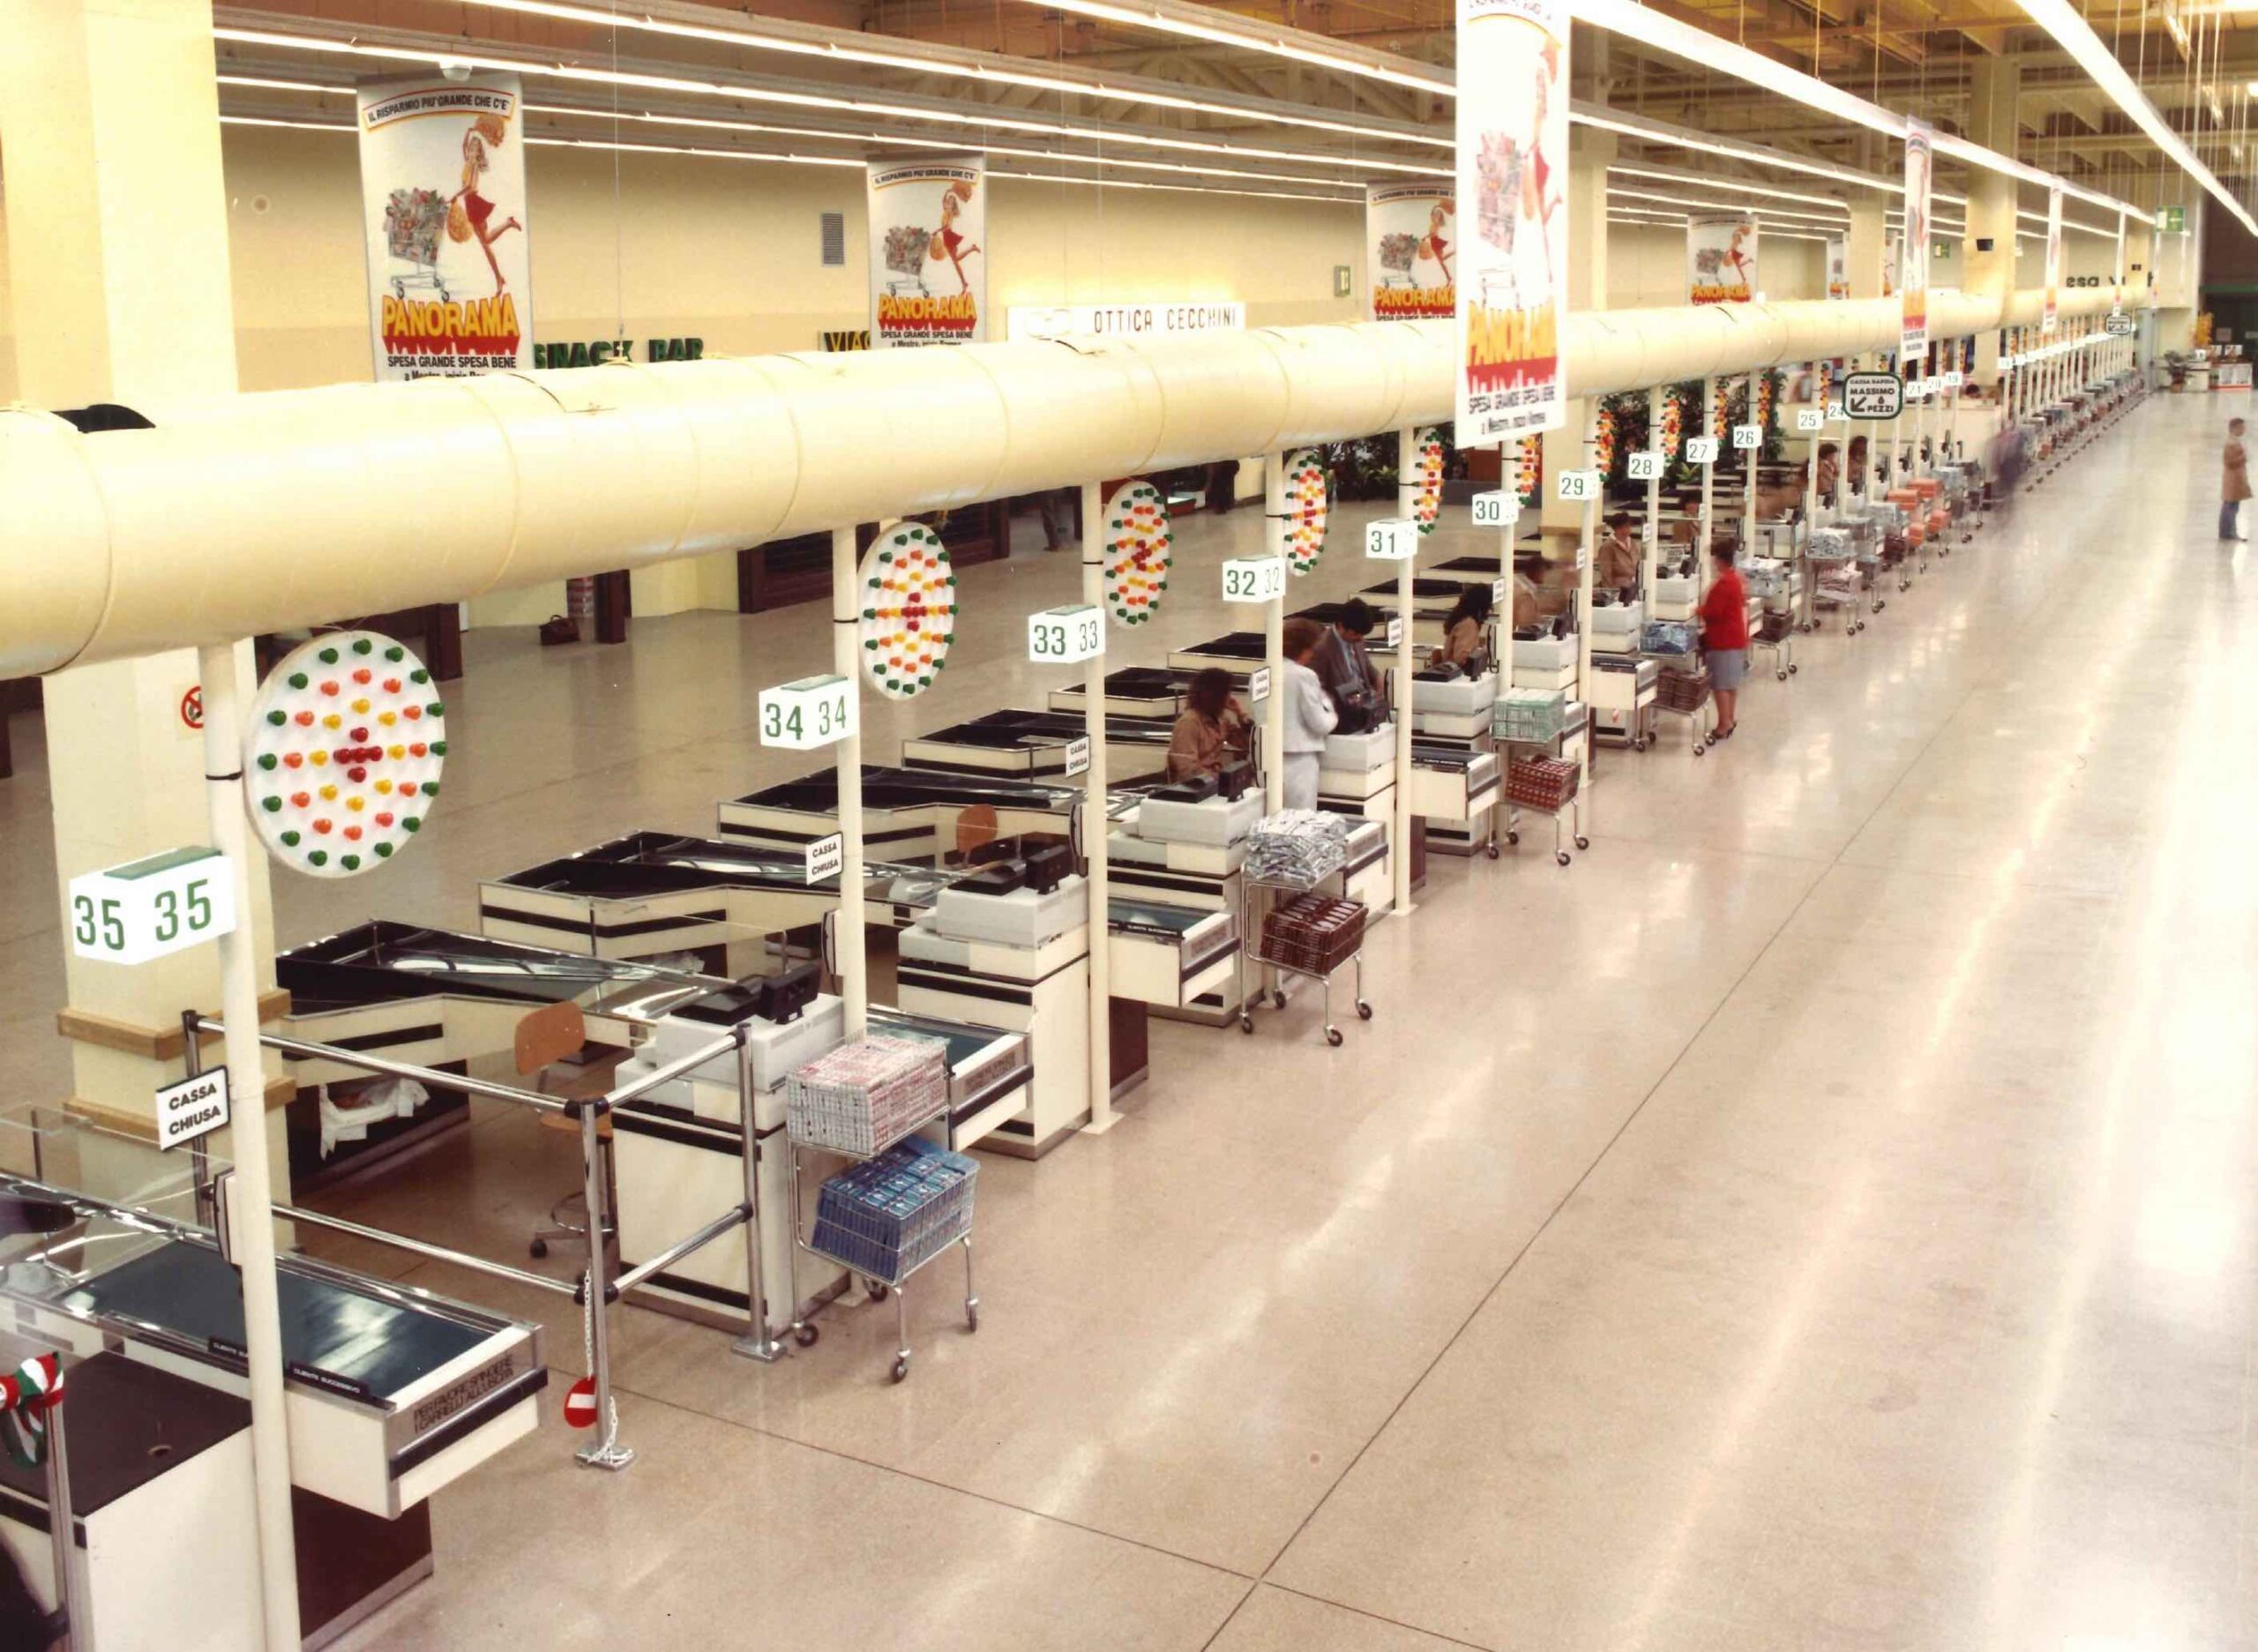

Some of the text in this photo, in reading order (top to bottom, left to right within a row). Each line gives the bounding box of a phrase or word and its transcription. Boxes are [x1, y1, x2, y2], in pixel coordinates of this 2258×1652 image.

[368, 111, 376, 122] IL
[377, 99, 420, 119] RISPARMIO
[437, 94, 473, 107] GRANDE
[475, 96, 491, 107] CHE
[382, 293, 520, 344] PANORAMA
[879, 292, 977, 324] PANORAMA
[1095, 307, 1236, 333] OTTICA CECCHINI
[880, 330, 974, 339] SPESA GRANDE SPESA BENE
[388, 355, 517, 369] SPESA GRANDE SPESA BENE
[649, 338, 705, 363] BAR
[1800, 414, 1817, 427] 25
[1736, 430, 1754, 445] 26
[1689, 444, 1708, 460] 27
[1631, 458, 1653, 475] 28
[1561, 477, 1584, 496] 29
[1475, 500, 1500, 520] 30
[1371, 530, 1395, 553] 31
[1226, 569, 1256, 595] 32
[1265, 566, 1279, 594] 32
[1034, 624, 1065, 655] 33
[1080, 619, 1098, 652] 33
[765, 703, 804, 741] 34
[819, 695, 847, 736] 34
[812, 841, 837, 857] CASSA
[811, 858, 839, 876] CHIUSA
[74, 894, 125, 952] 35
[154, 878, 212, 943] 35
[168, 1082, 217, 1110] CASSA
[168, 1105, 221, 1135] CHIUSA
